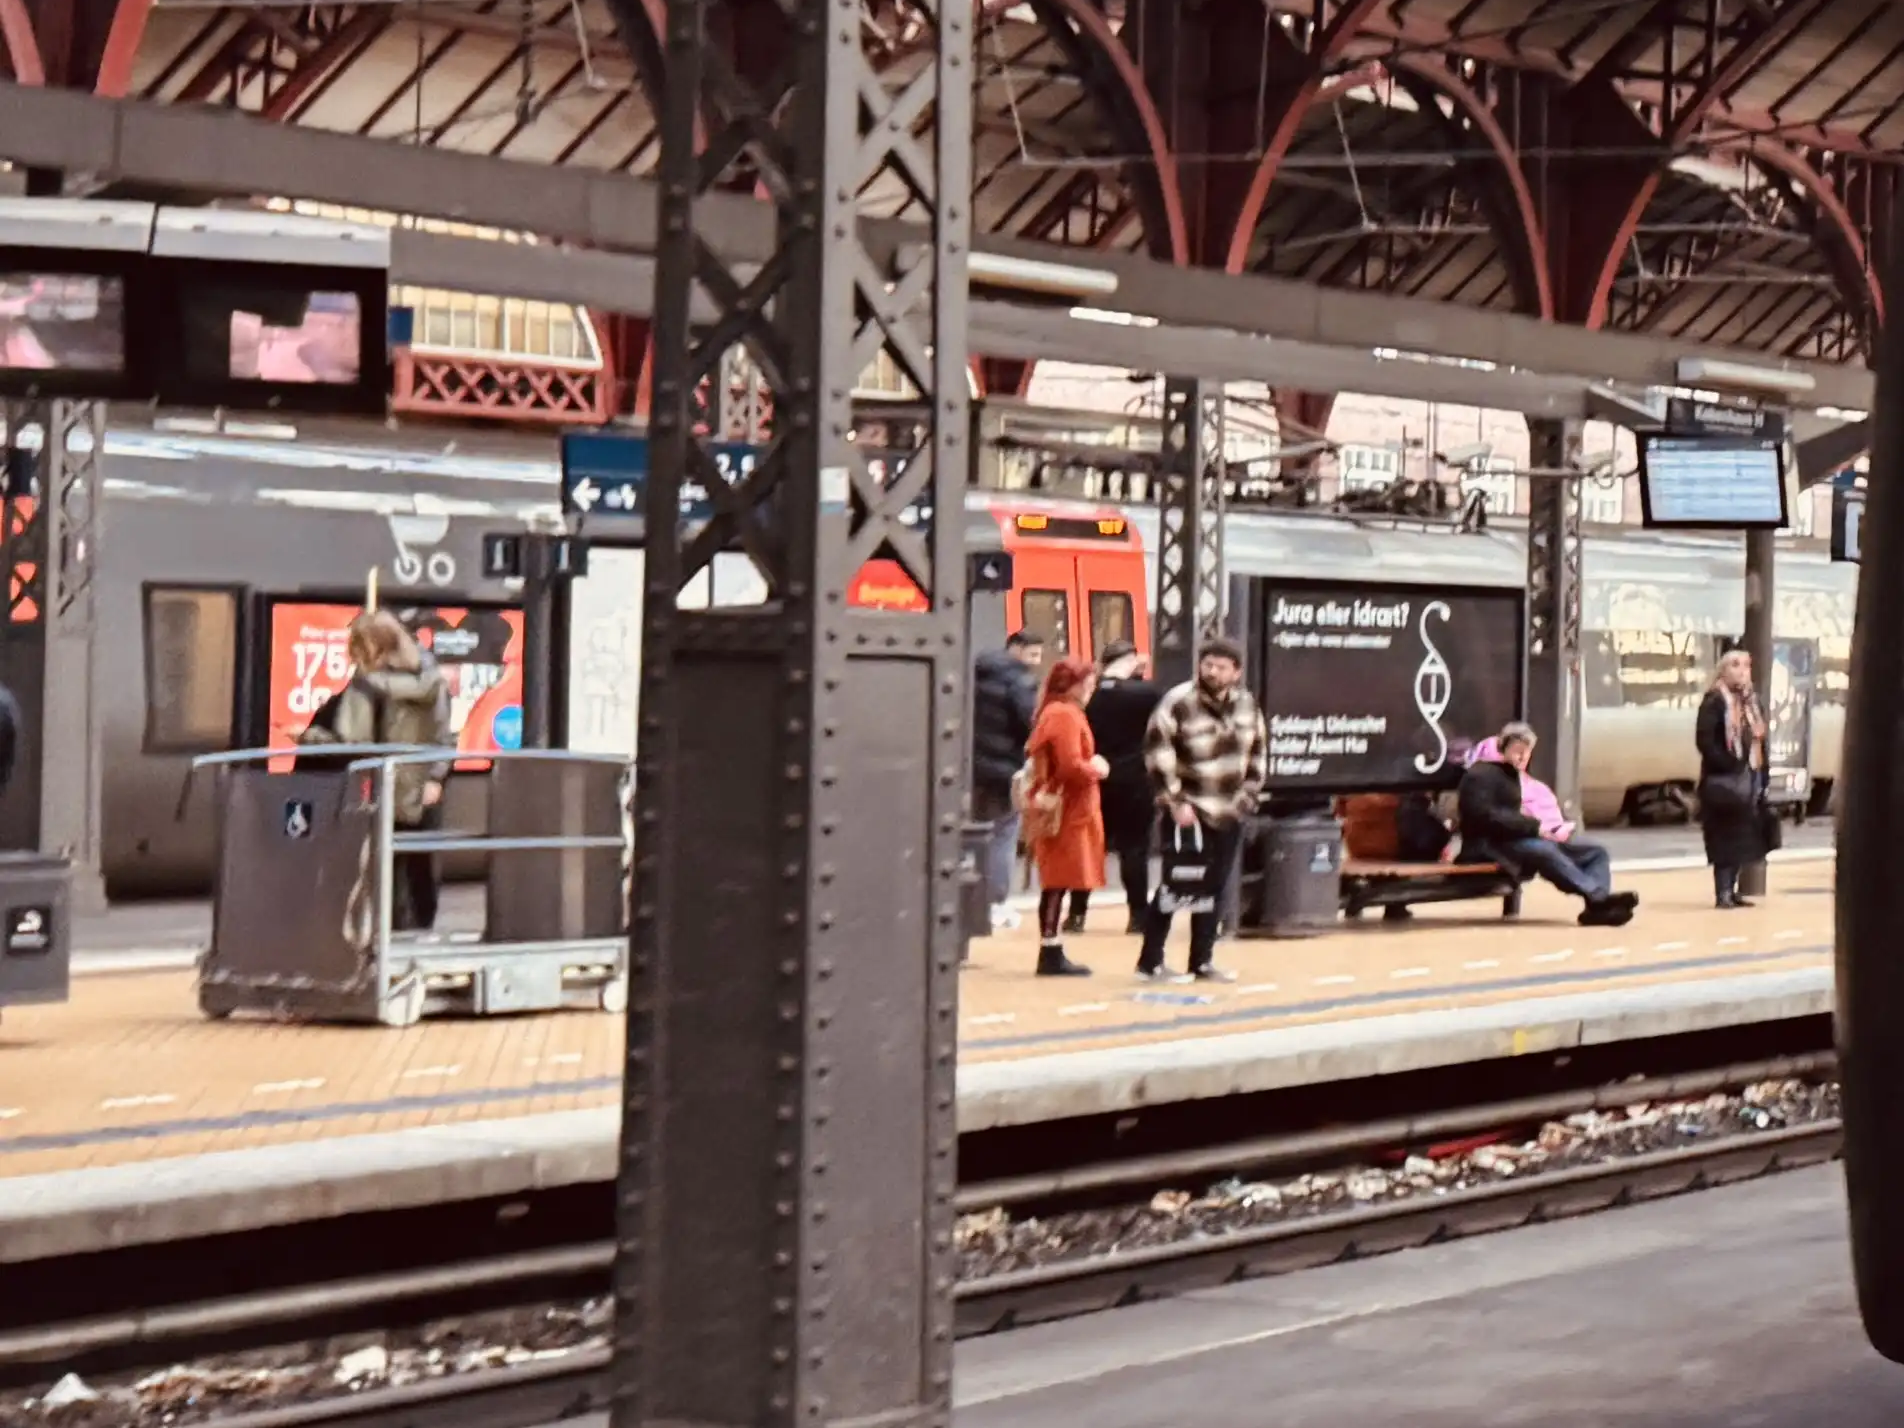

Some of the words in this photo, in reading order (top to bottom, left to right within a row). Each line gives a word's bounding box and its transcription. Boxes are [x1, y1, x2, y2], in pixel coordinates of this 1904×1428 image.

[1272, 598, 1314, 625] Jura
[1316, 600, 1352, 625] eller
[1354, 599, 1410, 628] idræt?
